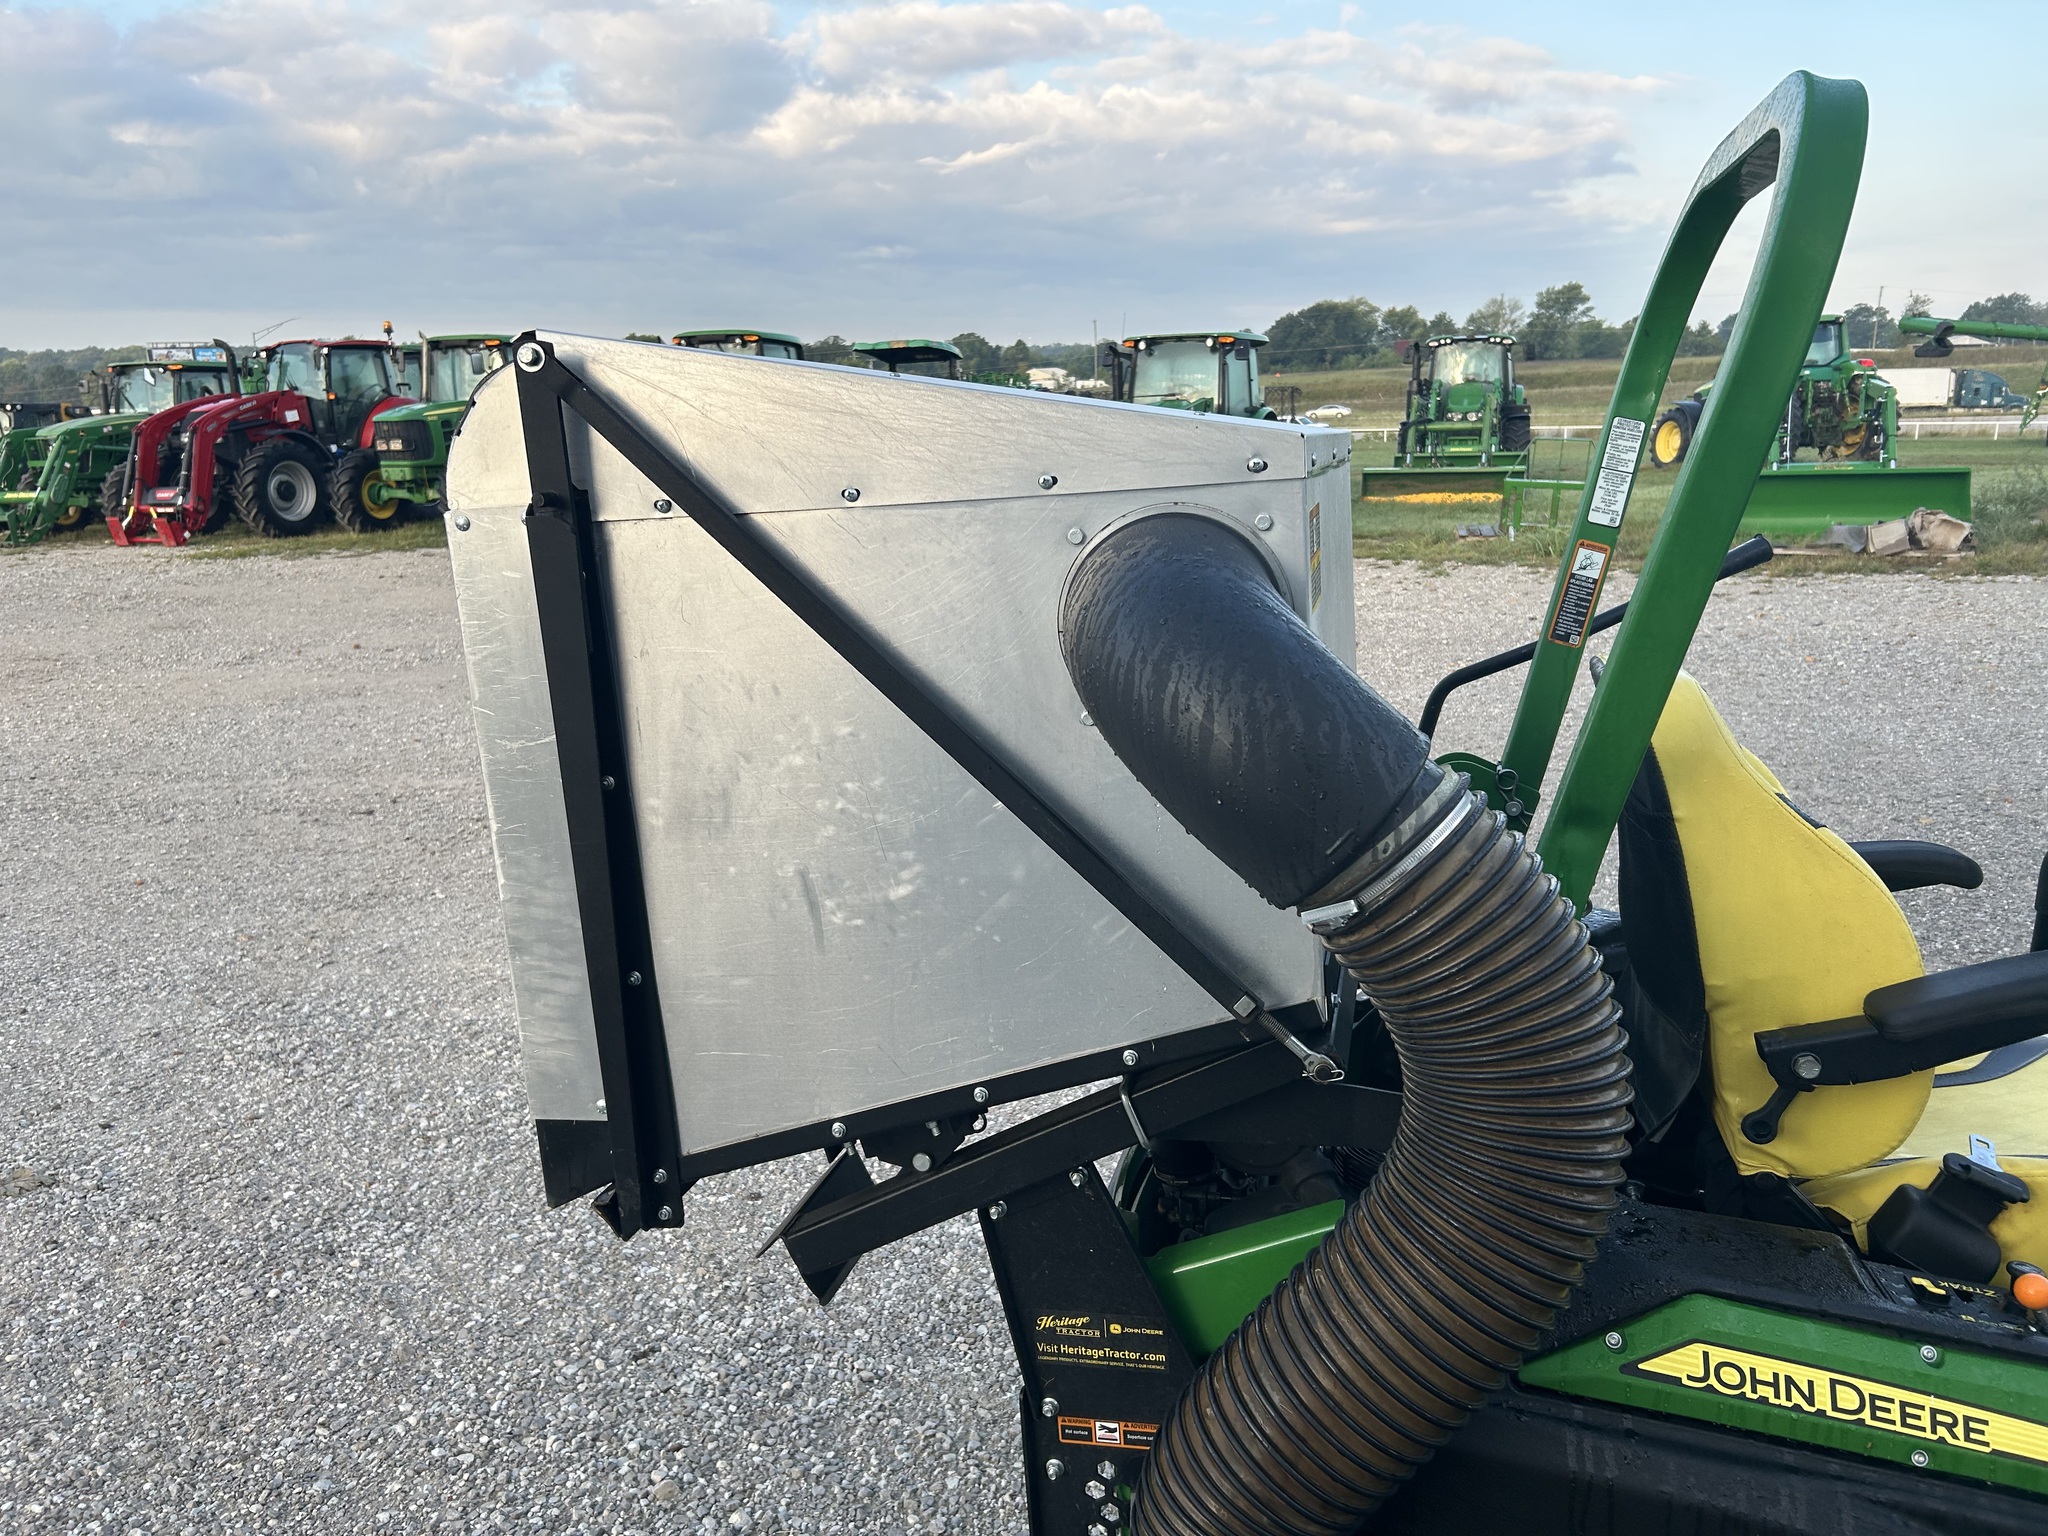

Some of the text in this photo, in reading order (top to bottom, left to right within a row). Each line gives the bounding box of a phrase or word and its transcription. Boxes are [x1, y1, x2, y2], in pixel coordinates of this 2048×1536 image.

[1036, 1315, 1090, 1330] Heritage
[1056, 1328, 1100, 1337] TRACTOR
[1122, 1326, 1164, 1336] JOHN DEERE
[1036, 1342, 1166, 1362] Visit HeritageTractor.com
[1686, 1350, 1991, 1448] JOHN DEERE
[1067, 1418, 1092, 1426] WARNING
